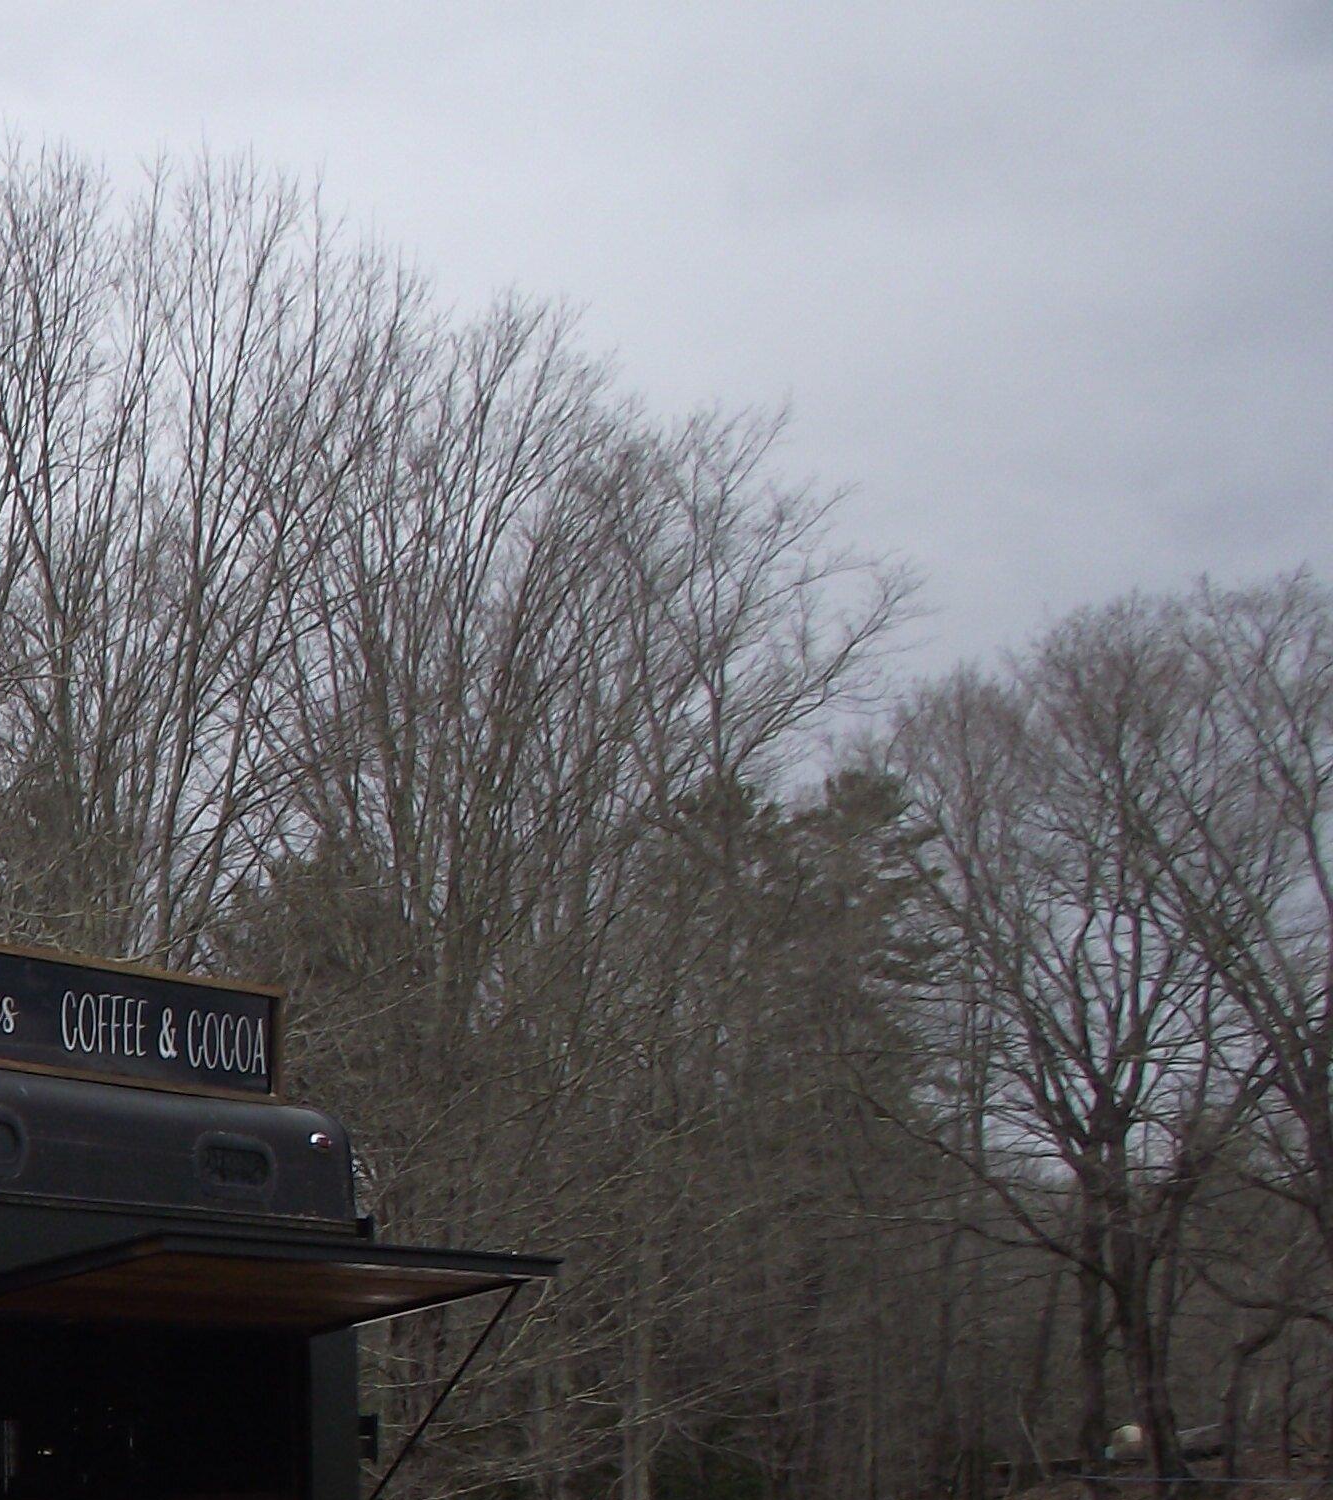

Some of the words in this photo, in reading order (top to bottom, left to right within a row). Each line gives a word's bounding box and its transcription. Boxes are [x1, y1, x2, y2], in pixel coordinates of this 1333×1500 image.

[60, 990, 148, 1058] COFFEE
[158, 1007, 177, 1060] &
[186, 1009, 267, 1076] COCOA
